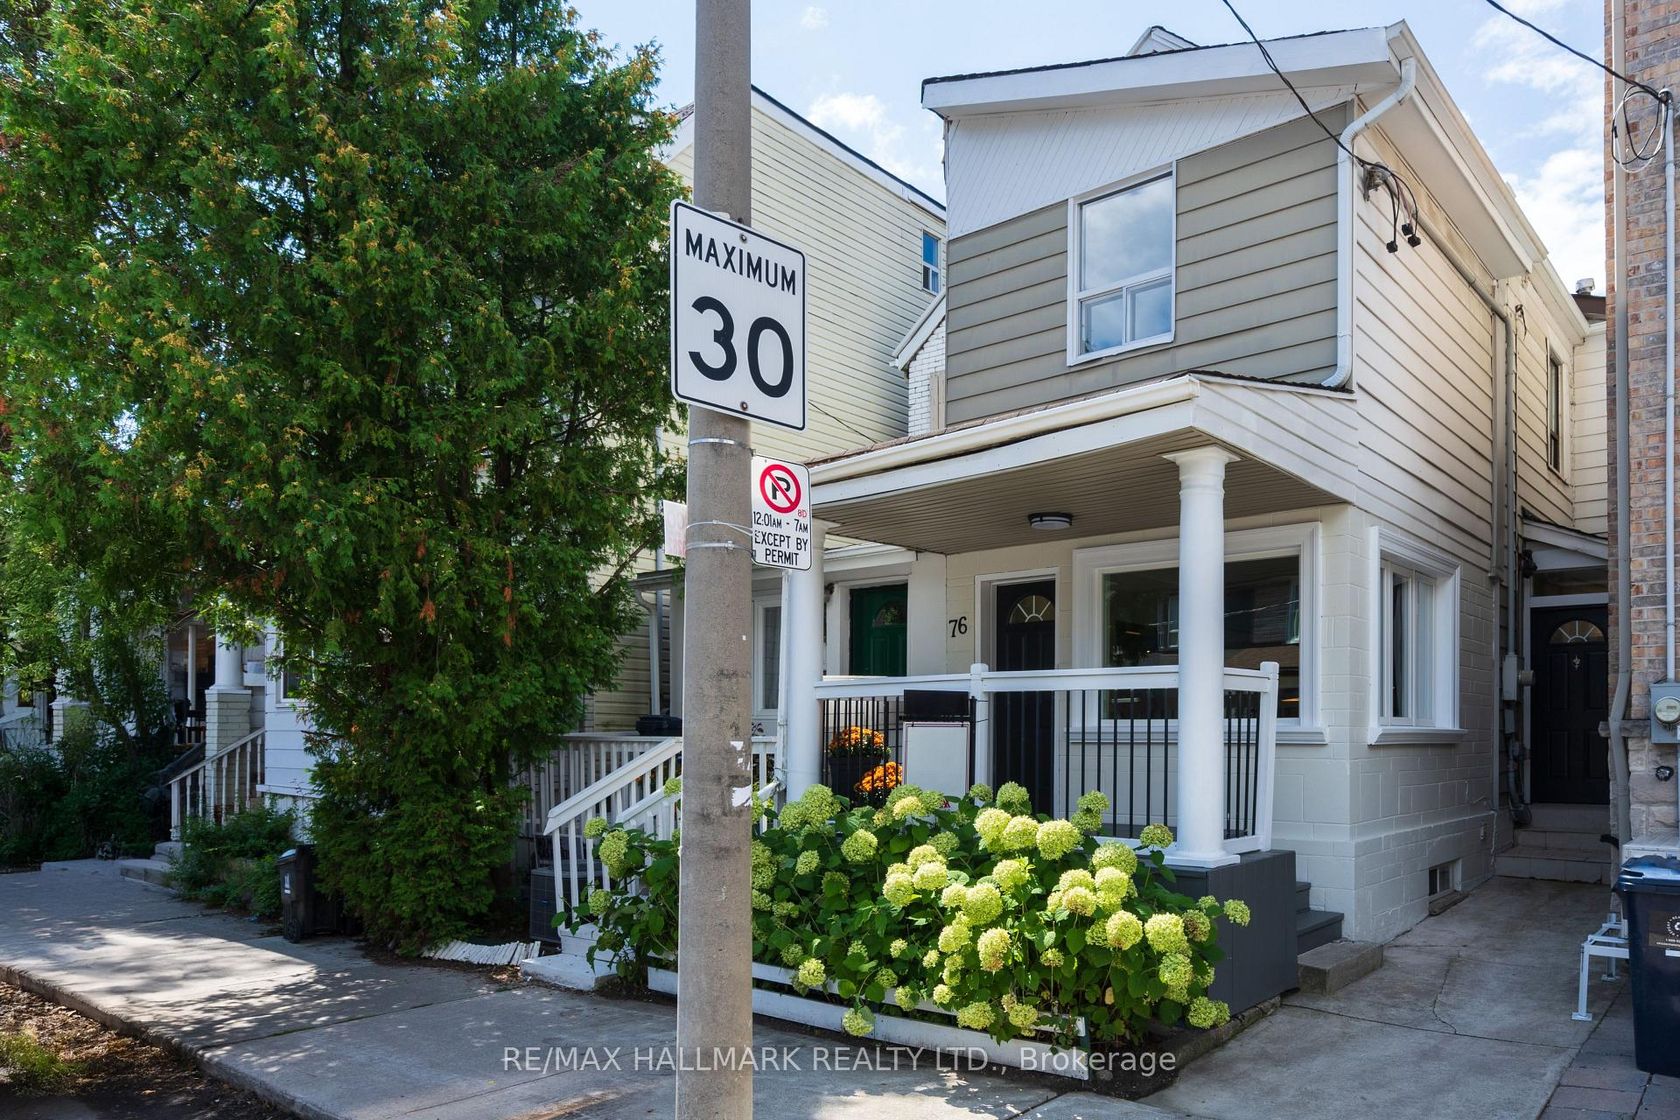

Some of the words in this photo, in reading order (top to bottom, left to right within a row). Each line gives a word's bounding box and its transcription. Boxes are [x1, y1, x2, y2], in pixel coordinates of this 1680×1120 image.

[685, 228, 796, 296] MAXIMUM
[688, 296, 794, 398] 30
[753, 511, 782, 529] 12:01AM
[794, 518, 809, 534] 7AM
[754, 529, 791, 549] EXCEPT
[796, 537, 809, 551] BY
[764, 548, 799, 566] PERMIT
[948, 616, 968, 638] 76
